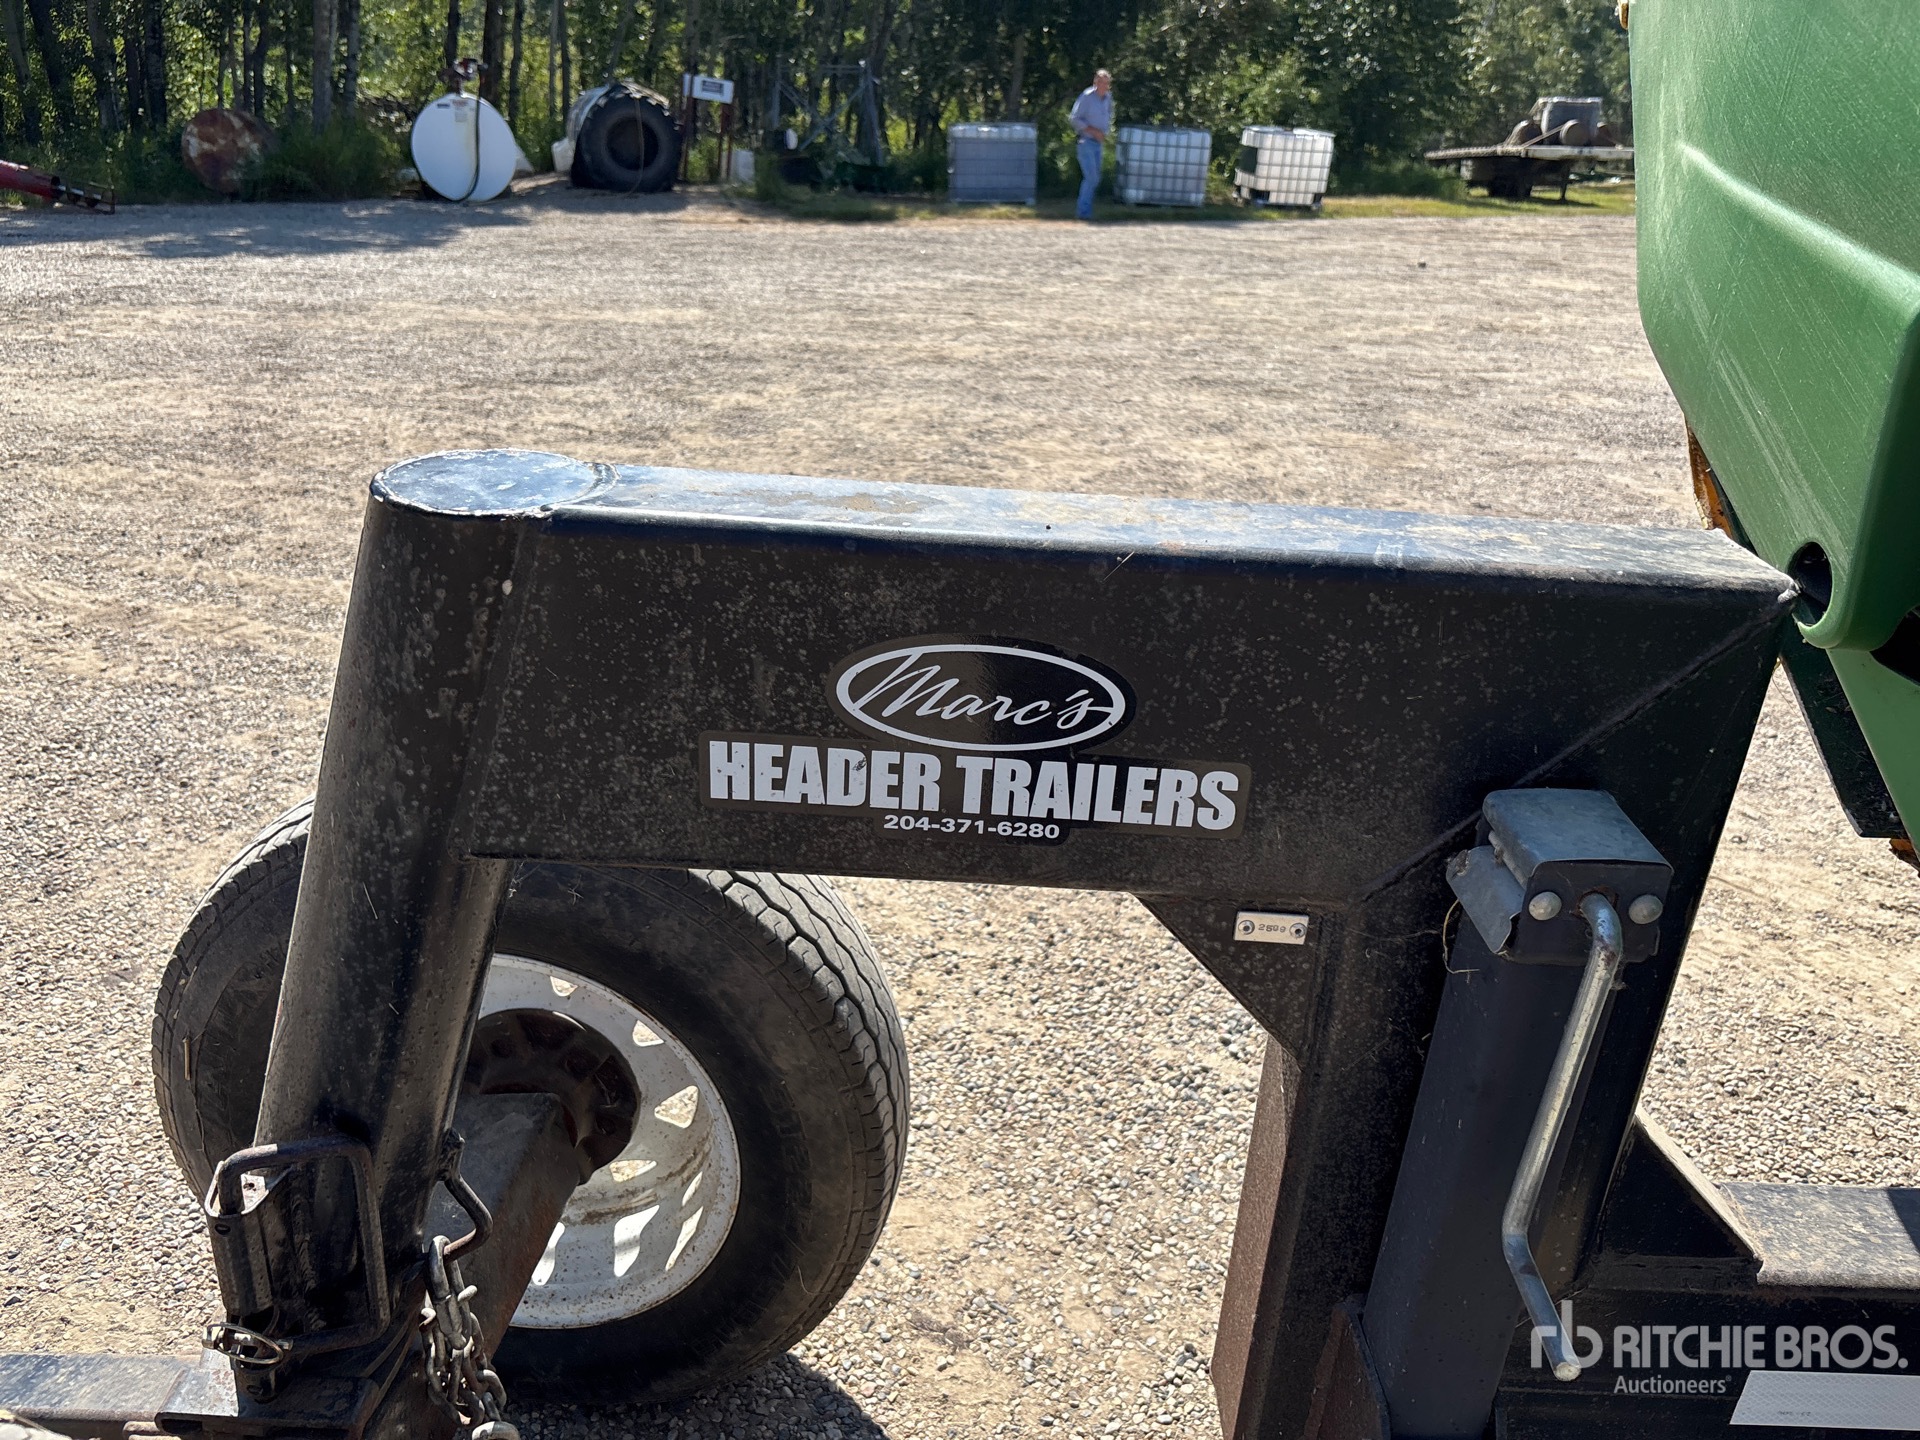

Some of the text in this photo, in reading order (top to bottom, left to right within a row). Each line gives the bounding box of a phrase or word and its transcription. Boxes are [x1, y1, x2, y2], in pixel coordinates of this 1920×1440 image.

[853, 652, 1112, 730] Marc's
[709, 740, 1239, 831] HEADER TRAILERS
[883, 814, 1060, 839] 204-371-6280
